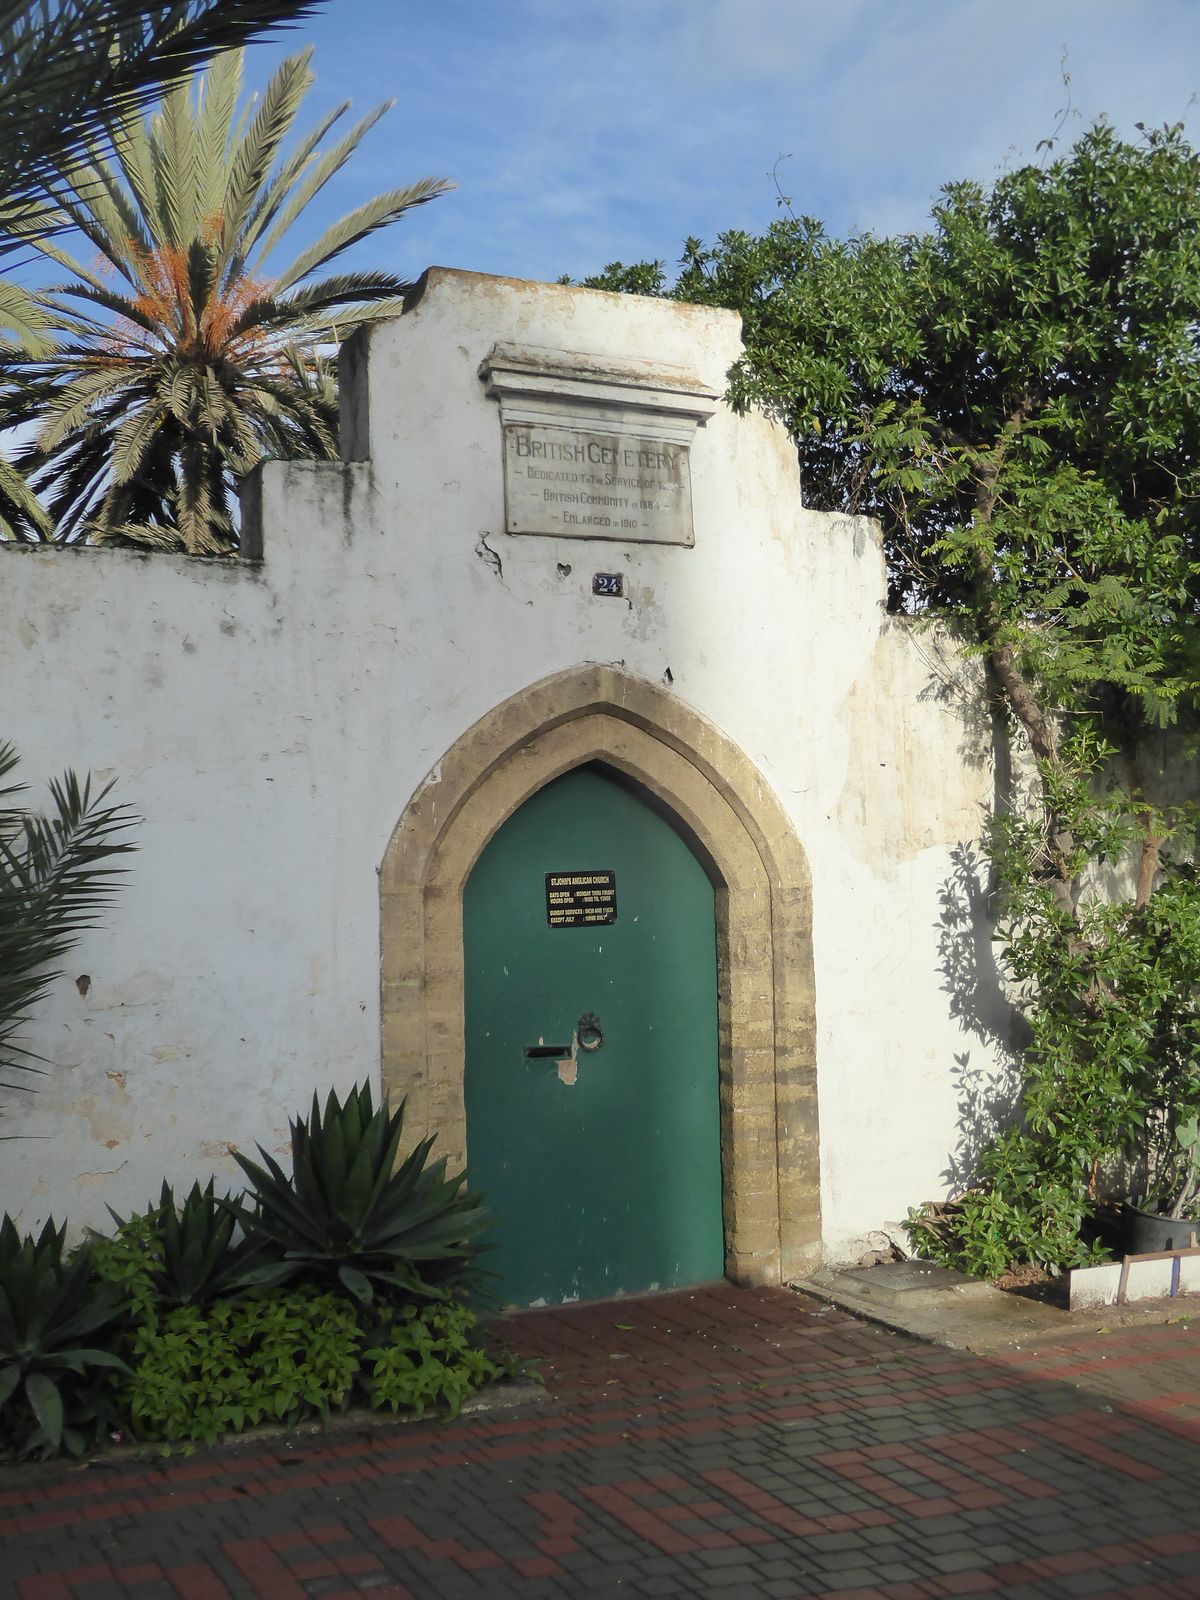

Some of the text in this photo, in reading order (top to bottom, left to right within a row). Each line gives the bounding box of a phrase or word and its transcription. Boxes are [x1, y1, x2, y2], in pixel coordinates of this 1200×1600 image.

[516, 435, 585, 463] BRITISH
[527, 466, 578, 482] DEDICATED
[605, 472, 641, 489] SERVICE
[543, 488, 579, 504] BRITISH
[563, 511, 611, 527] ENLARGED
[620, 519, 638, 529] 1910
[598, 577, 619, 593] 24
[572, 877, 592, 885] ANGLICAN
[593, 876, 609, 884] CHURCH
